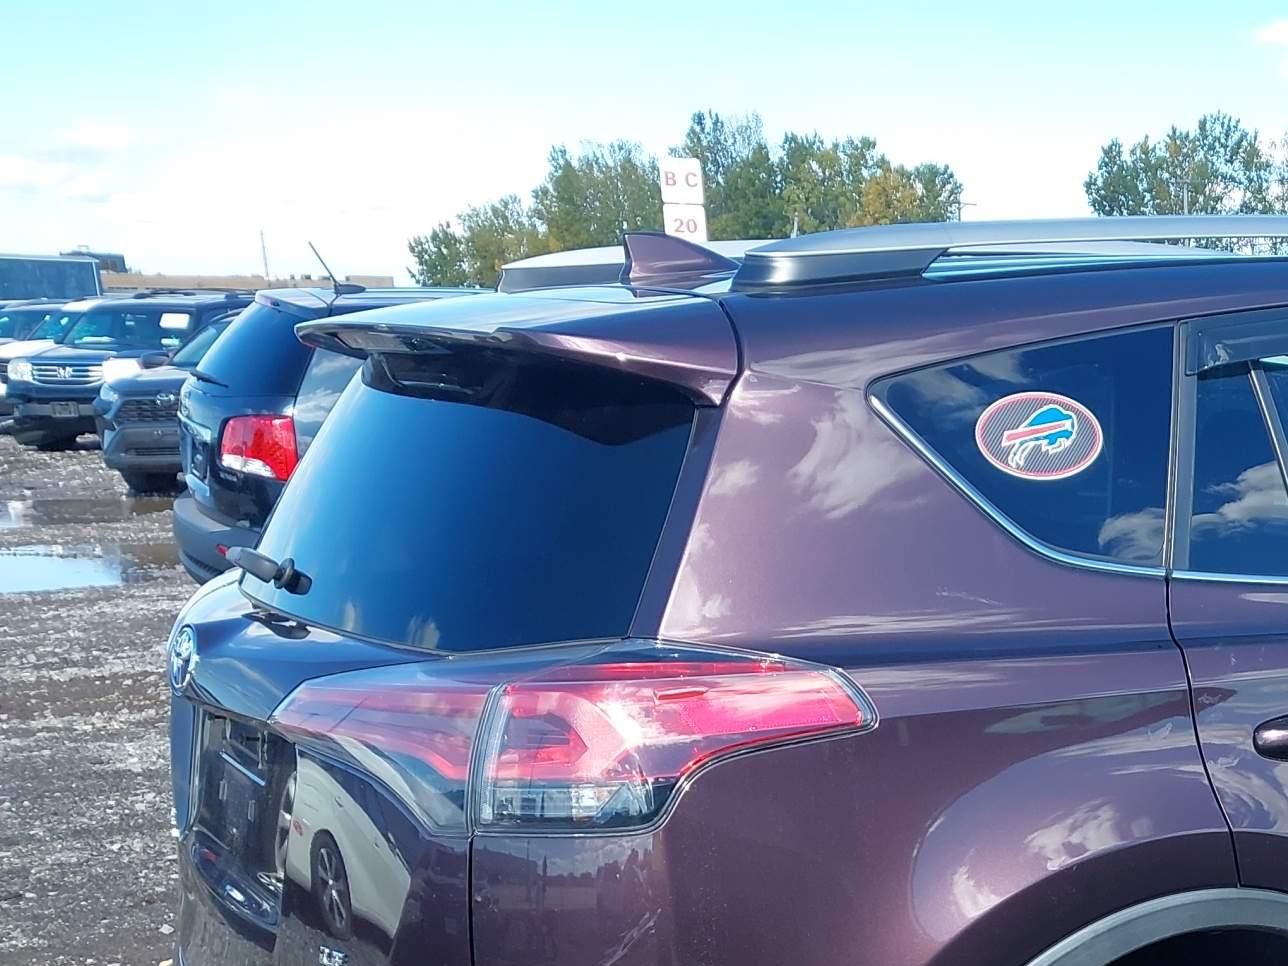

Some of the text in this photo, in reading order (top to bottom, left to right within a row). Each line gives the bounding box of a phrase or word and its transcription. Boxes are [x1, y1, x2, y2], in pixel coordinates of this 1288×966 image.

[663, 170, 698, 188] B C
[673, 217, 698, 234] 20
